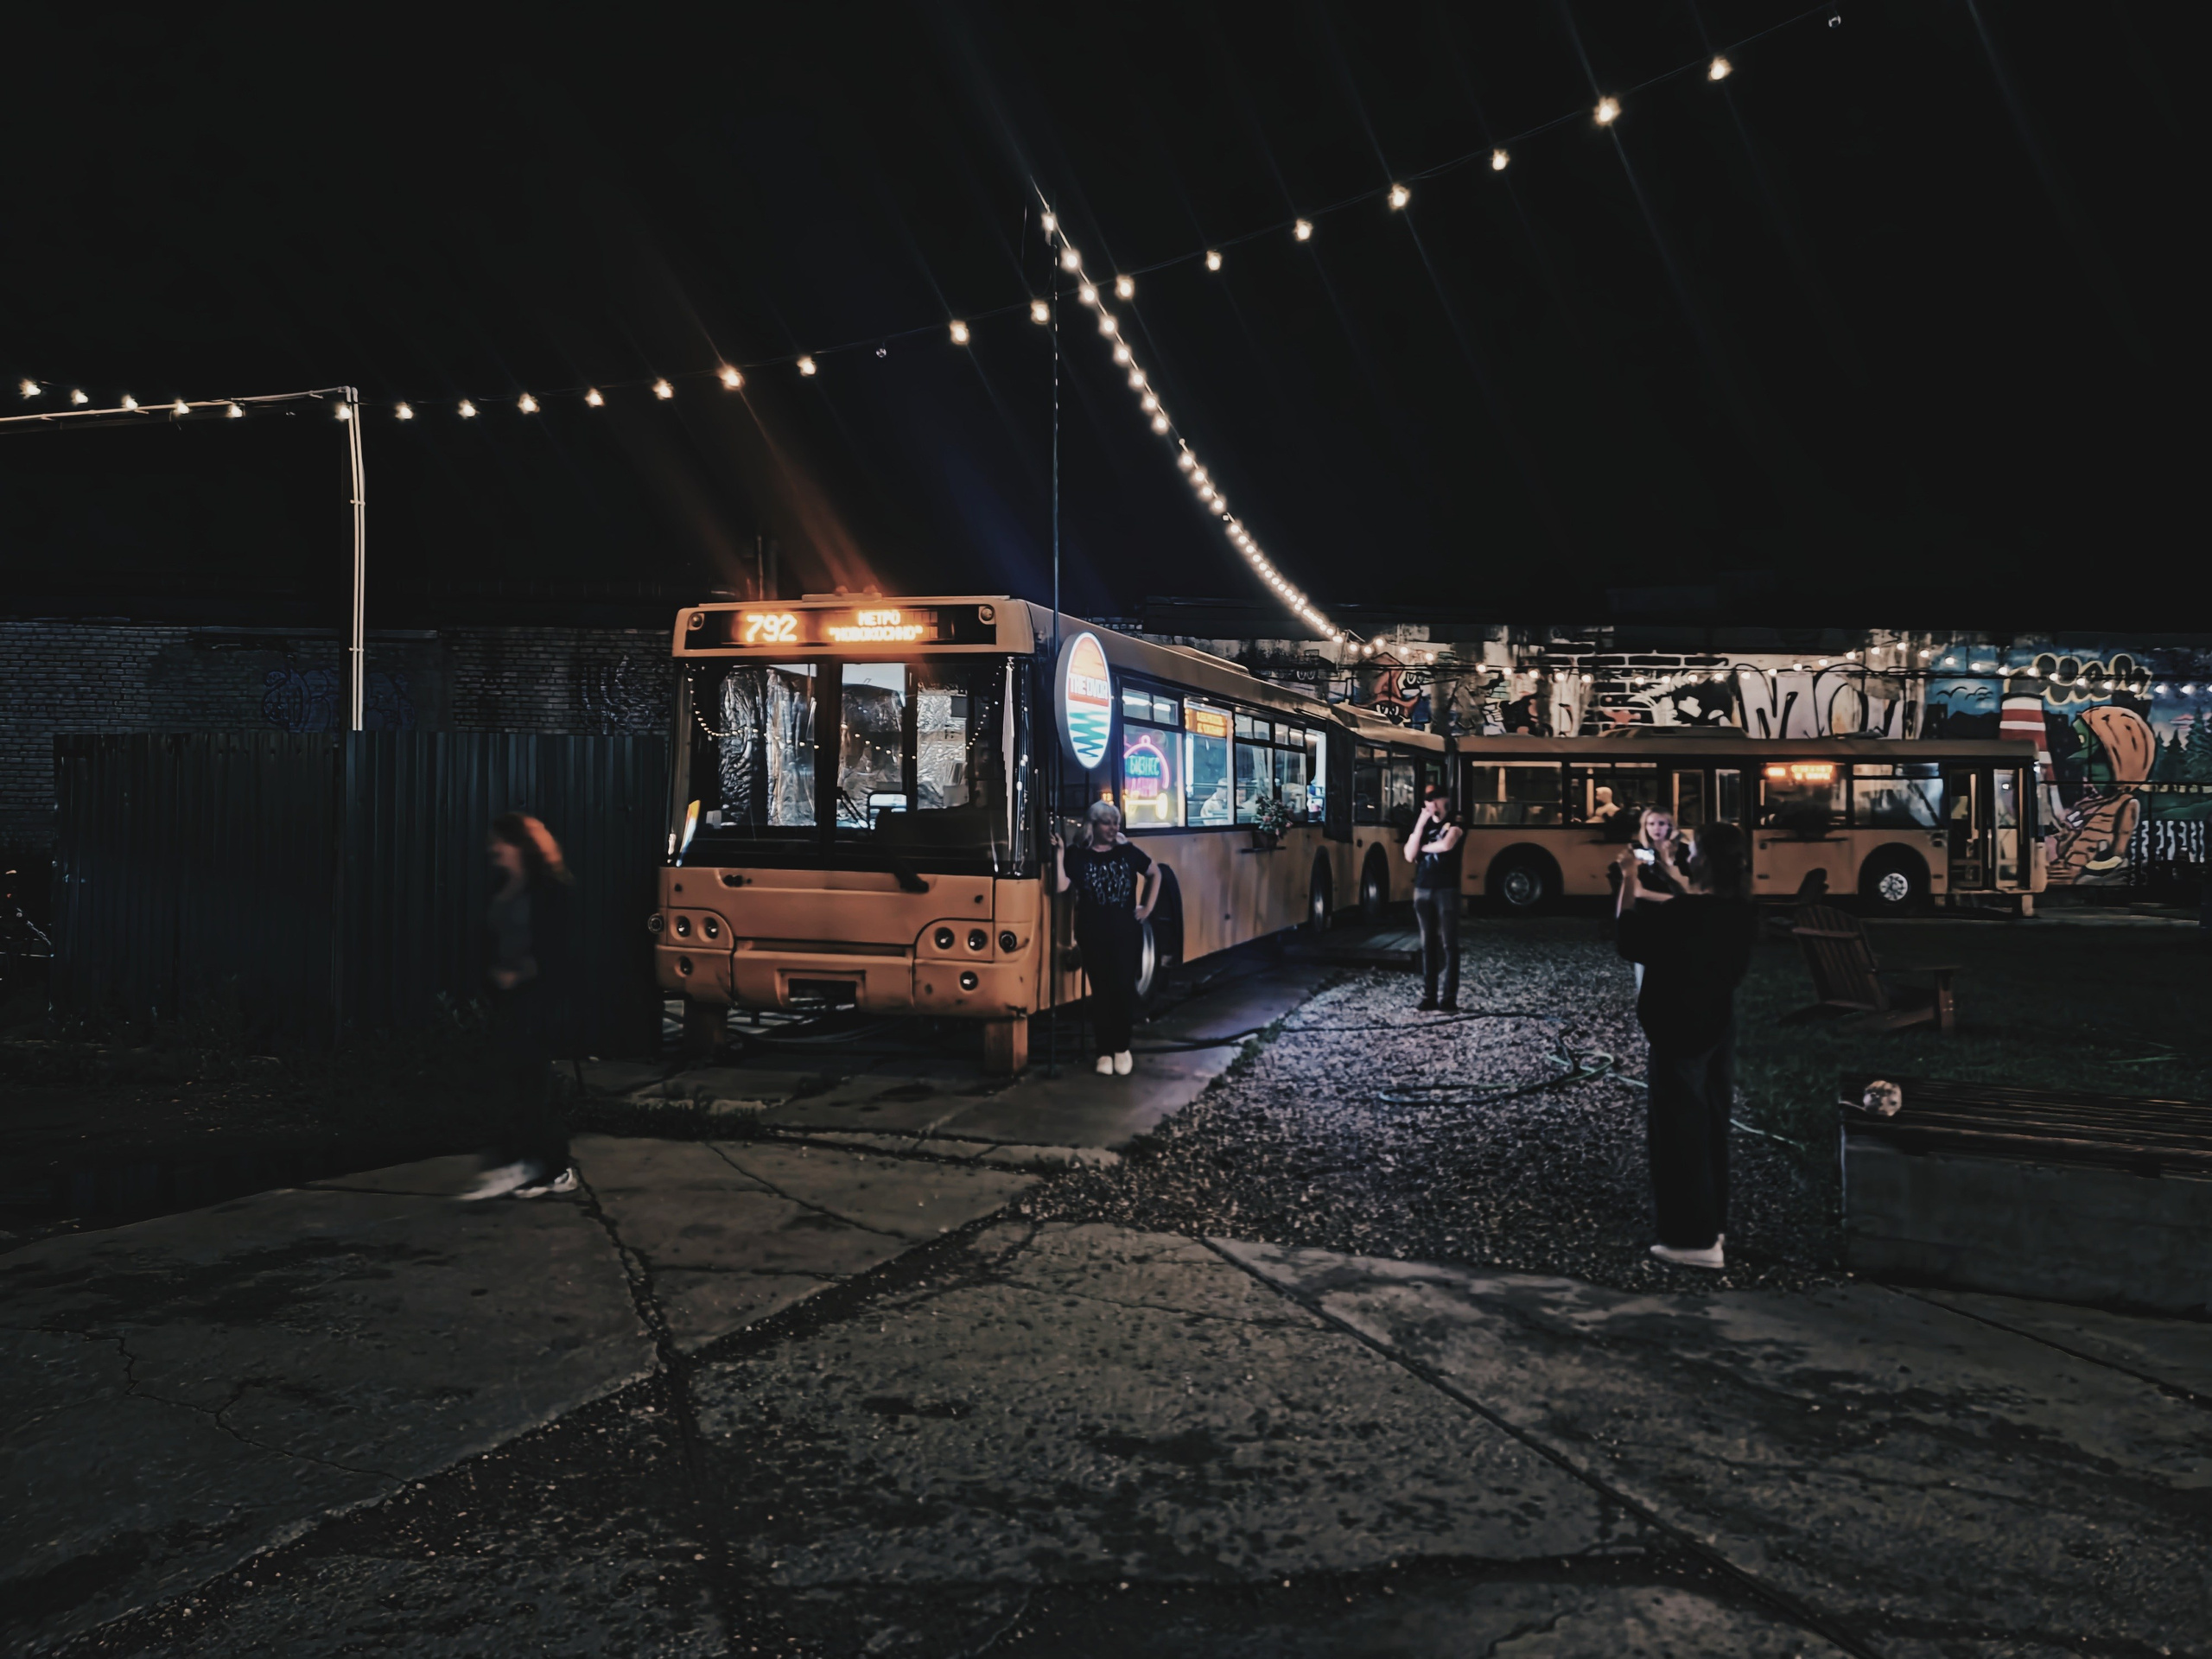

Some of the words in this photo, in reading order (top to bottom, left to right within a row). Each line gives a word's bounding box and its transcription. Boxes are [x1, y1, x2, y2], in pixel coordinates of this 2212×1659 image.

[747, 614, 798, 642] 792
[858, 610, 900, 626] МЕТРО
[1070, 673, 1086, 695] THE
